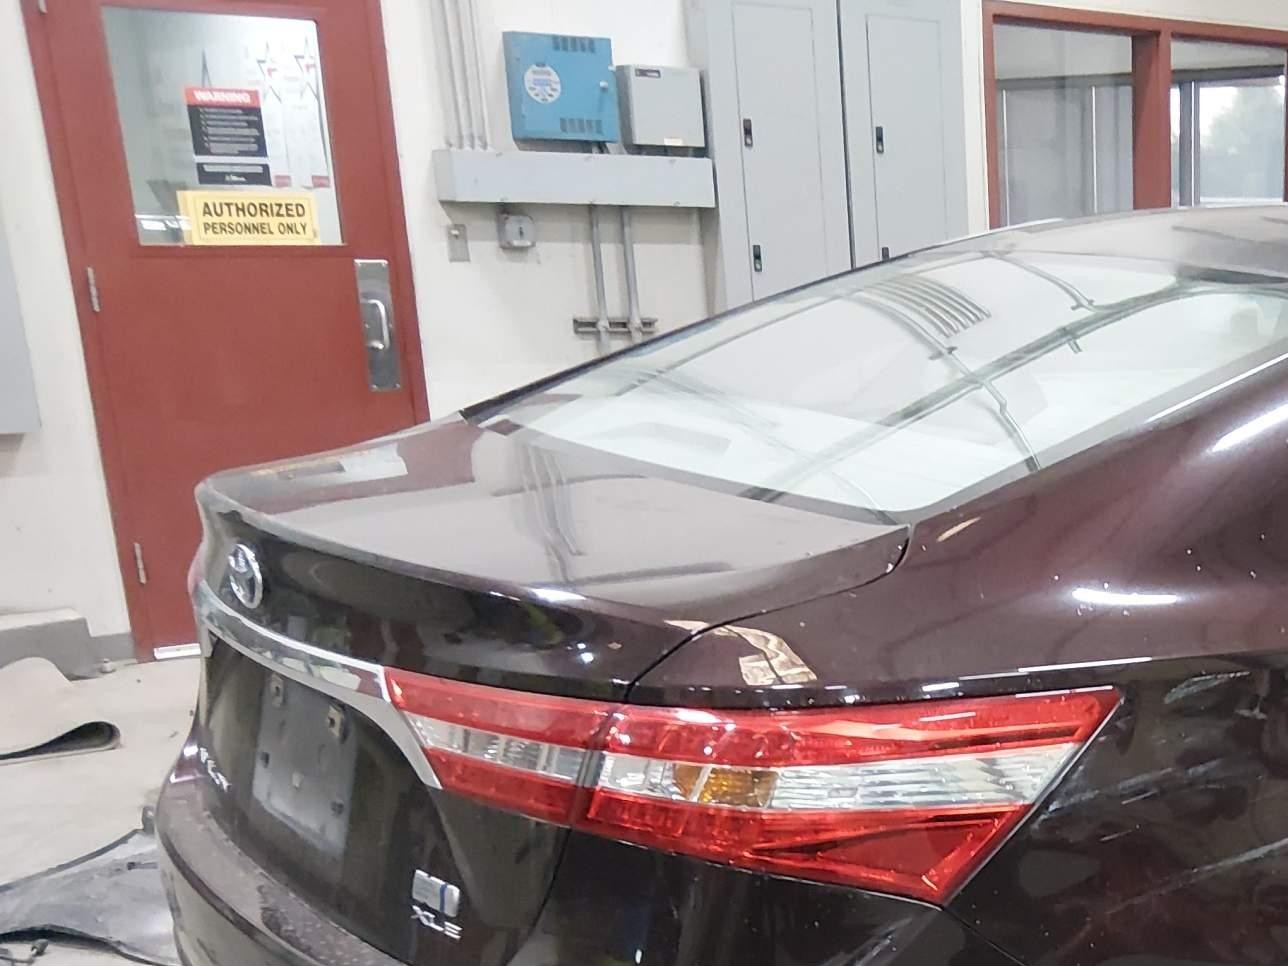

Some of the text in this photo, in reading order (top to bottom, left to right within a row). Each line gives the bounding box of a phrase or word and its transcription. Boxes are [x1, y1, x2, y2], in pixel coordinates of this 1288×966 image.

[193, 90, 251, 103] WARNING
[202, 201, 306, 218] AUTHORIZED
[203, 222, 308, 235] PERSONNEL ONLY
[410, 905, 464, 940] XLE
